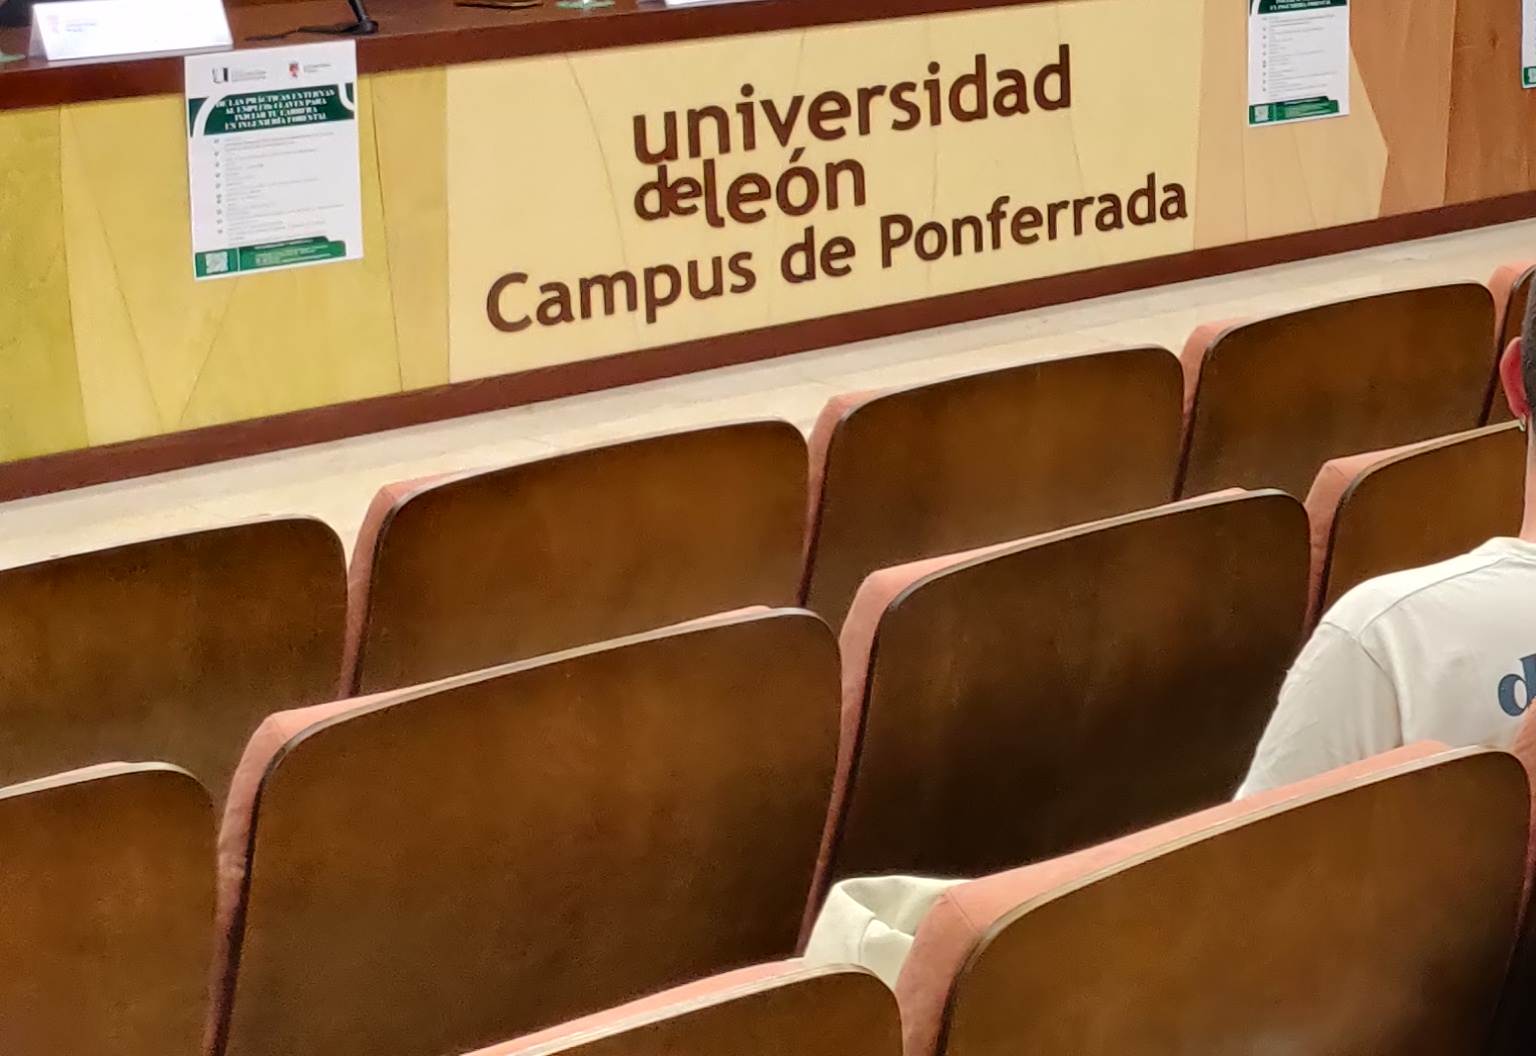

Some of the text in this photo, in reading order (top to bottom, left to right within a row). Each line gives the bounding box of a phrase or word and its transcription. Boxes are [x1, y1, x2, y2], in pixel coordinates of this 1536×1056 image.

[632, 44, 1072, 165] universidad
[633, 146, 867, 229] de león
[485, 172, 1189, 334] Campus de Ponferrada
